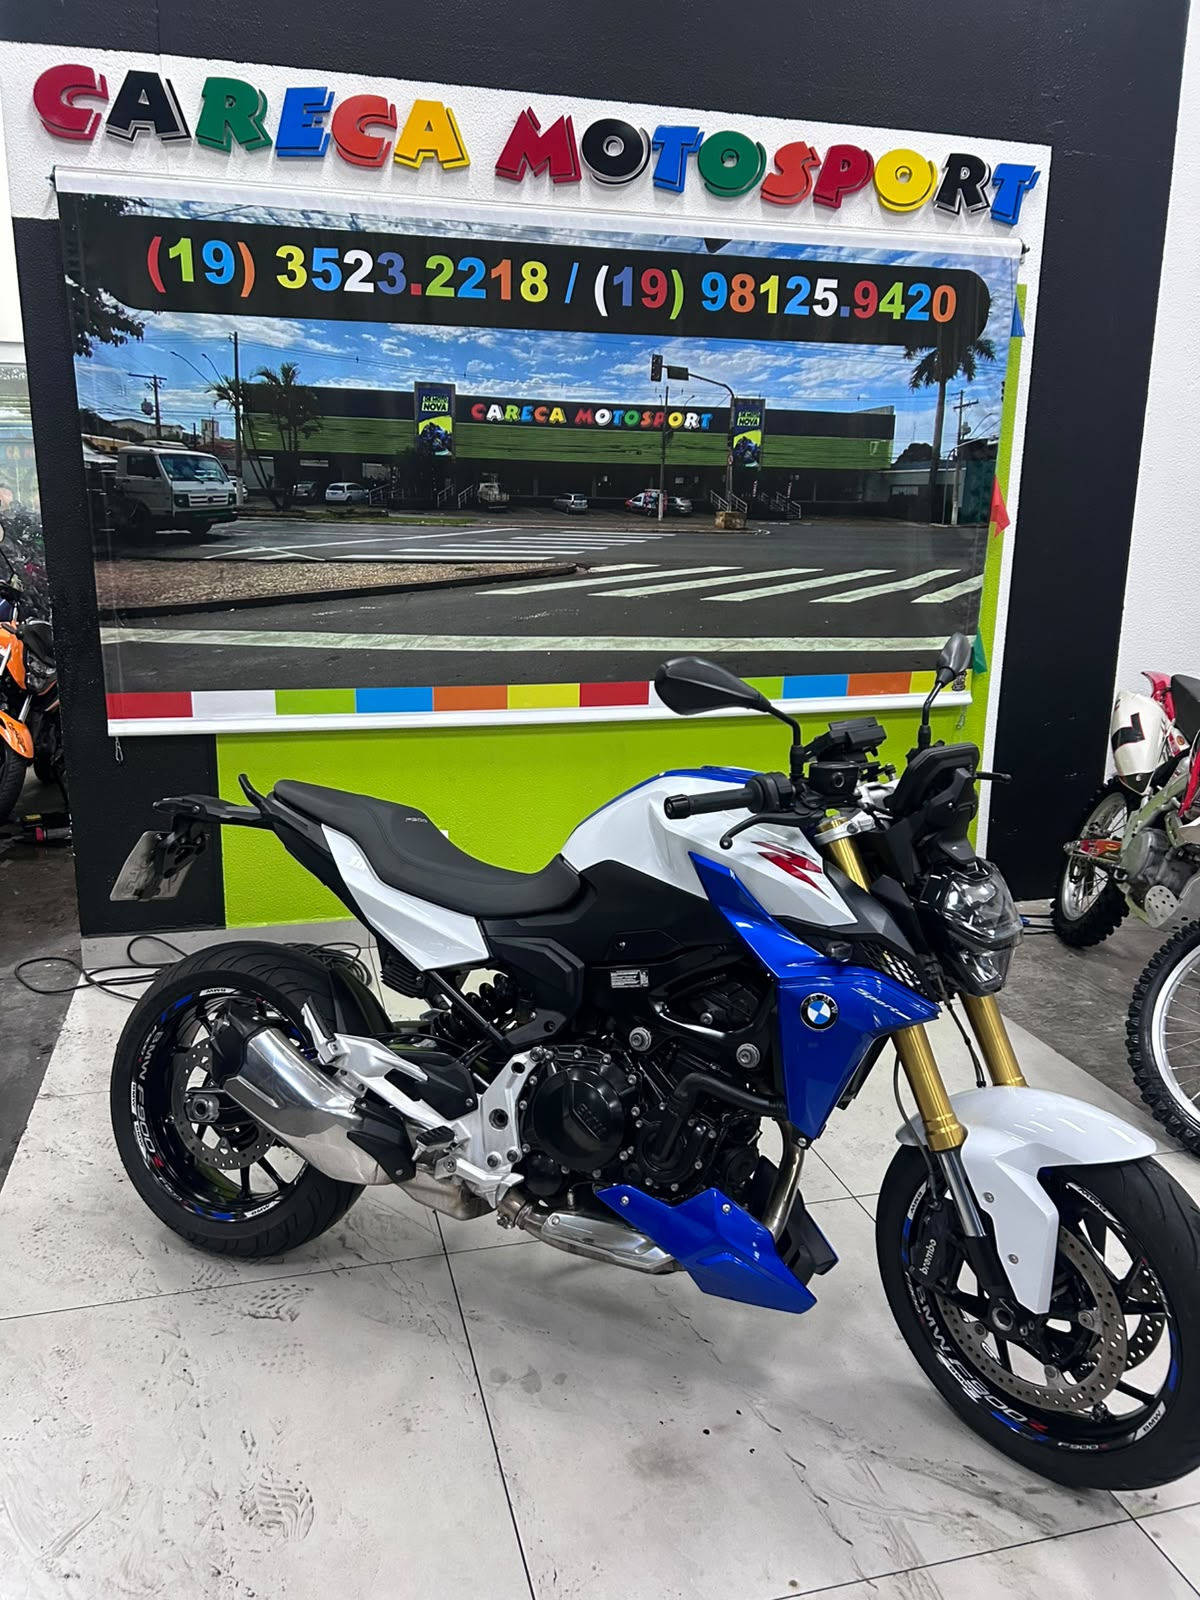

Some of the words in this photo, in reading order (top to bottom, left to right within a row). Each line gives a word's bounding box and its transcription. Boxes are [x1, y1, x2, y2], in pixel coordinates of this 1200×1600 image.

[33, 63, 470, 169] CARECA
[495, 107, 1041, 226] MOTOSPORT
[146, 236, 256, 298] (19)
[275, 244, 549, 302] 3523.2218
[593, 264, 684, 320] (19)
[700, 271, 957, 323] 98125.9420
[470, 403, 566, 424] CARECA
[574, 408, 714, 430] MOTOSPORT
[139, 1031, 164, 1081] BMW
[919, 1238, 937, 1276] brembo
[916, 1286, 952, 1350] BMW
